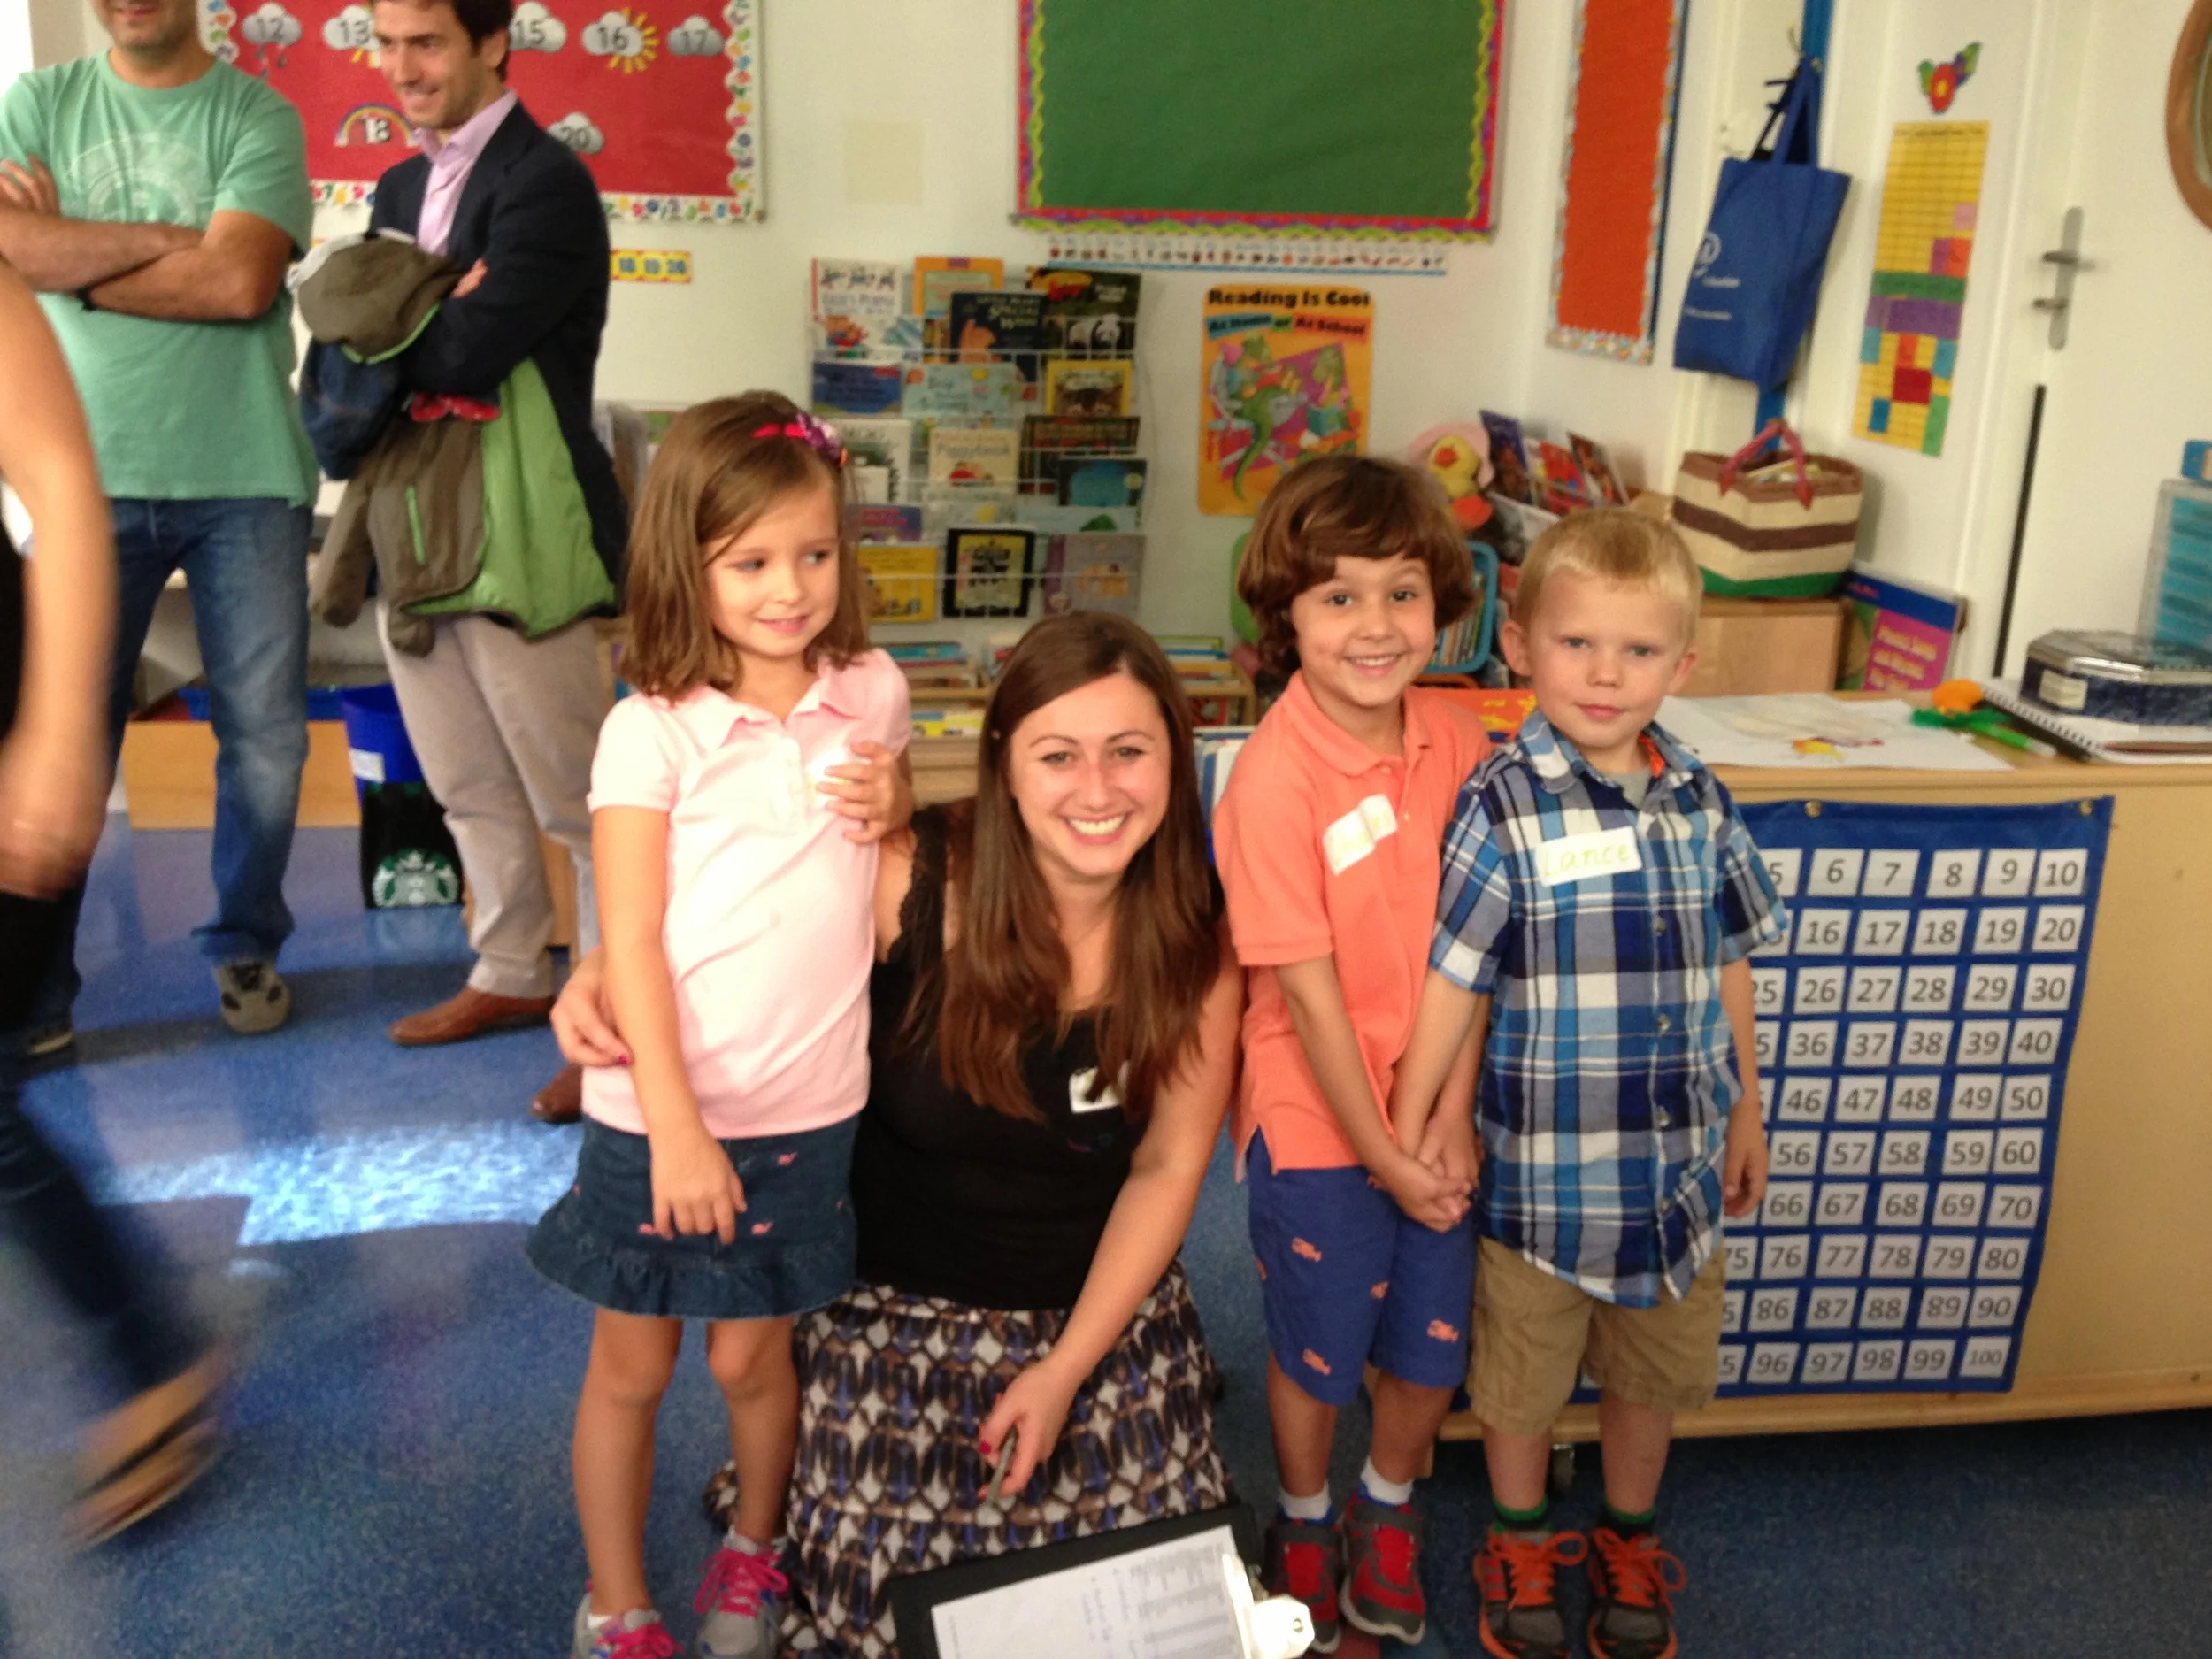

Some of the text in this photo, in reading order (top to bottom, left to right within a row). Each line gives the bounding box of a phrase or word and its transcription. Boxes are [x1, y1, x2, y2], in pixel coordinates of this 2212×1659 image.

[256, 17, 708, 50] 12 13 15 16 17
[1208, 288, 1371, 309] Reading Is Cool
[1543, 843, 1631, 878] Lance
[1769, 857, 2079, 888] 5 6 7 8 9 10
[1804, 919, 1841, 947] 16
[1864, 921, 1901, 947] 17
[1922, 920, 1958, 946] 18
[1983, 918, 2019, 946] 19
[2040, 917, 2077, 944] 20
[1801, 978, 1838, 1004] 26
[1857, 977, 1893, 1003] 27
[1911, 976, 1947, 1003] 28
[1972, 976, 2008, 1003] 29
[2030, 976, 2067, 1002] 30
[1792, 1032, 1829, 1058] 36
[1852, 1033, 1889, 1058] 37
[1907, 1031, 1943, 1056] 38
[1966, 1030, 2001, 1056] 39
[2017, 1029, 2053, 1056] 40
[1785, 1087, 1822, 1115] 46
[1844, 1087, 1879, 1113] 47
[1896, 1086, 1933, 1112] 48
[1957, 1085, 1993, 1112] 49
[2009, 1085, 2045, 1113] 50
[1776, 1139, 2038, 1167] 56 57 58 59 60
[1769, 1191, 2032, 1221] 66 67 68 69 70
[1770, 1243, 1803, 1270] 76
[1826, 1245, 1859, 1270] 77
[1878, 1244, 1913, 1270] 78
[1932, 1245, 1967, 1271] 79
[1984, 1247, 2020, 1272] 80
[1755, 1295, 1791, 1322] 86
[1812, 1297, 1849, 1322] 87
[1868, 1296, 1903, 1322] 88
[1925, 1294, 1962, 1320] 89
[1977, 1295, 2012, 1320] 90
[1755, 1348, 1790, 1375] 96
[1809, 1349, 1846, 1376] 97
[1862, 1347, 1896, 1372] 98
[1912, 1347, 1947, 1372] 99
[1967, 1348, 2003, 1368] 100
